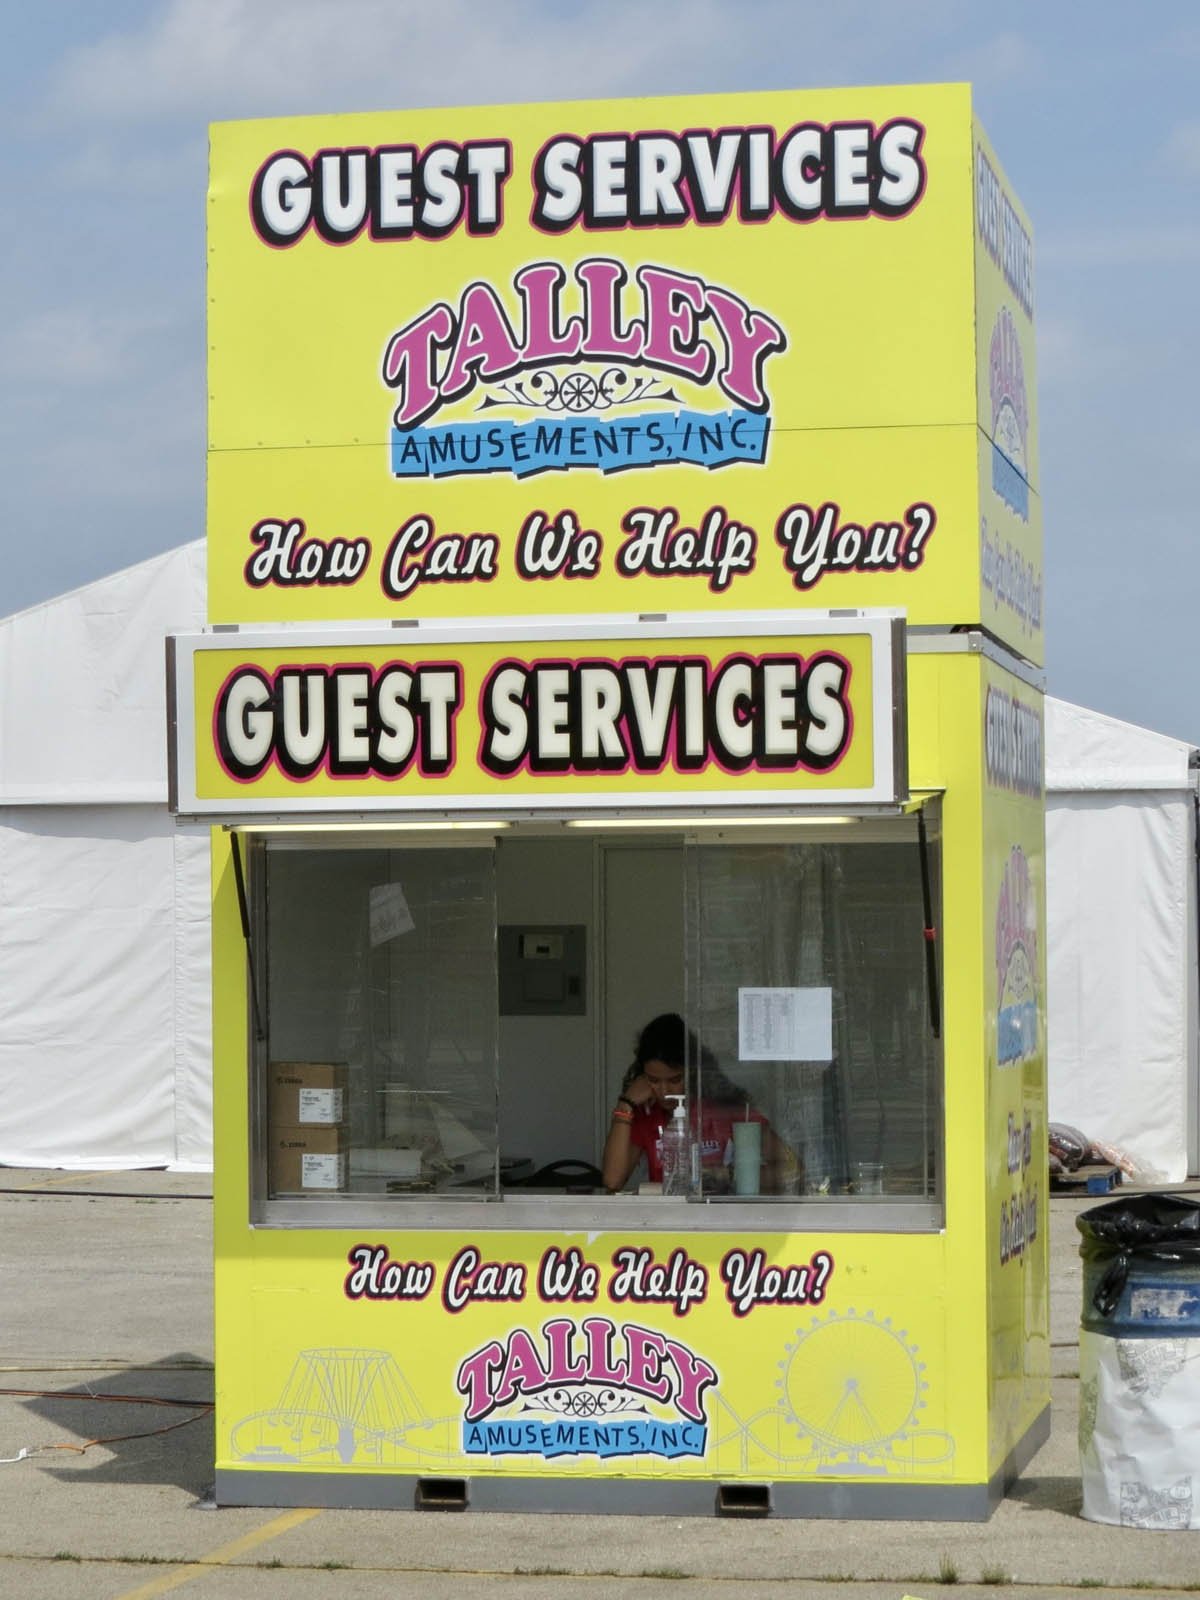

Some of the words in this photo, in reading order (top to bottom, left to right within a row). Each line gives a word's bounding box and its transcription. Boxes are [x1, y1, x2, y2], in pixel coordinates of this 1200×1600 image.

[252, 140, 511, 247] GUEST
[531, 119, 926, 232] SERVICES
[383, 258, 788, 430] TALLEY
[246, 517, 369, 588] How
[381, 515, 498, 600] Can
[515, 508, 601, 581] We
[616, 504, 756, 593] Help
[777, 501, 935, 592] You?
[214, 661, 463, 783] GUEST
[478, 651, 853, 779] SERVICES
[345, 1243, 434, 1302] How
[443, 1244, 526, 1315] Can
[538, 1243, 600, 1302] We
[608, 1243, 707, 1315] Help
[720, 1246, 833, 1318] You?
[458, 1317, 719, 1424] TALLEY
